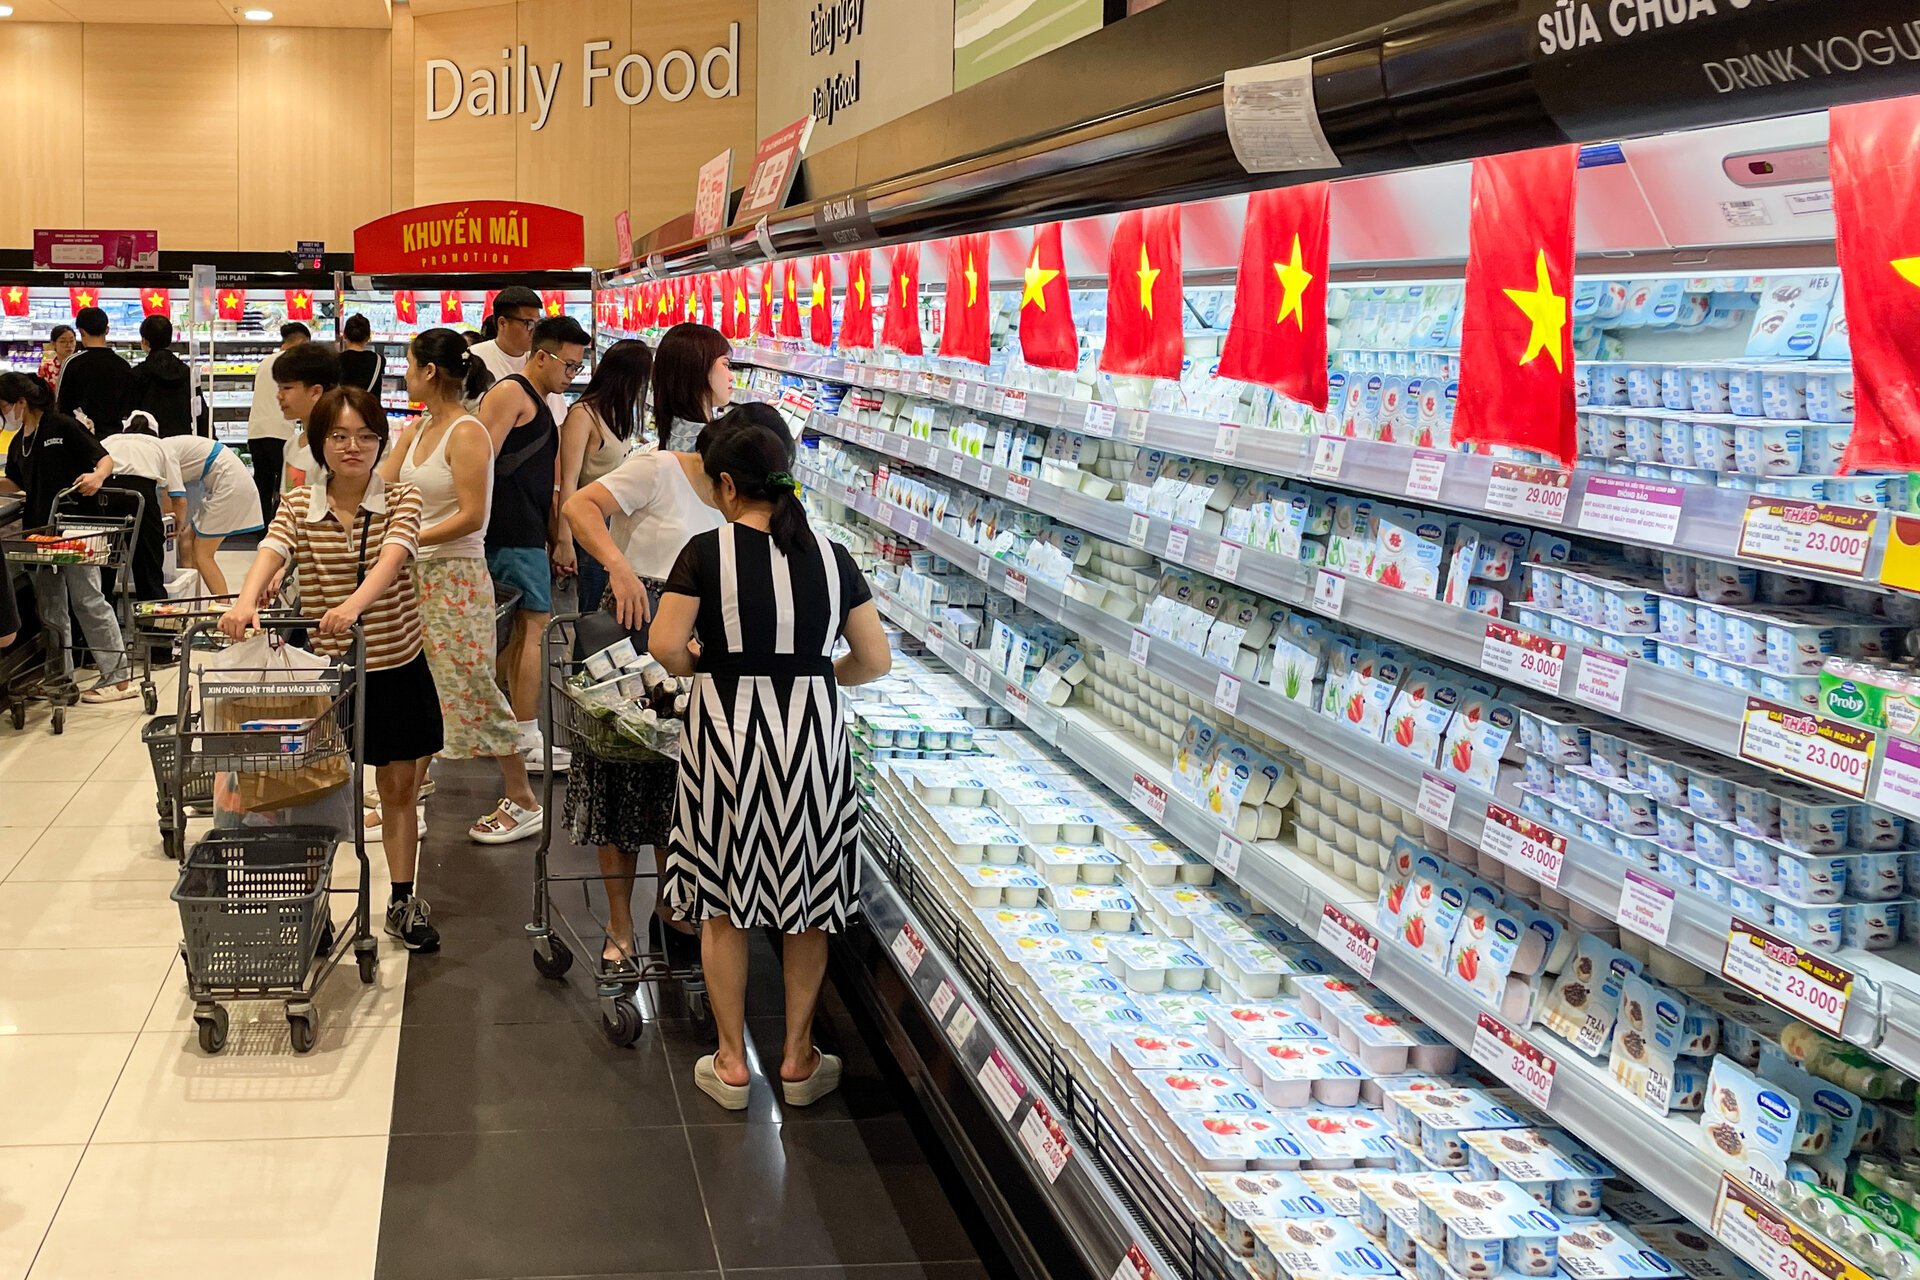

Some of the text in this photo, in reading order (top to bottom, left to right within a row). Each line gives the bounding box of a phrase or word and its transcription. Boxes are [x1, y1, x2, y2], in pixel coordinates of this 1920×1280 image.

[426, 21, 740, 131] Daily Food
[1702, 46, 1809, 93] DRINK
[834, 60, 860, 111] Food
[402, 207, 528, 254] KHUYẾN MÃI
[421, 251, 509, 268] PROMOTION
[1784, 506, 1819, 523] THẤP
[1835, 514, 1858, 525] NGÀY
[208, 686, 221, 694] XIN
[1782, 716, 1817, 734] THẤP
[1764, 941, 1798, 966] THẤP
[1759, 1093, 1791, 1118] VINAMILK
